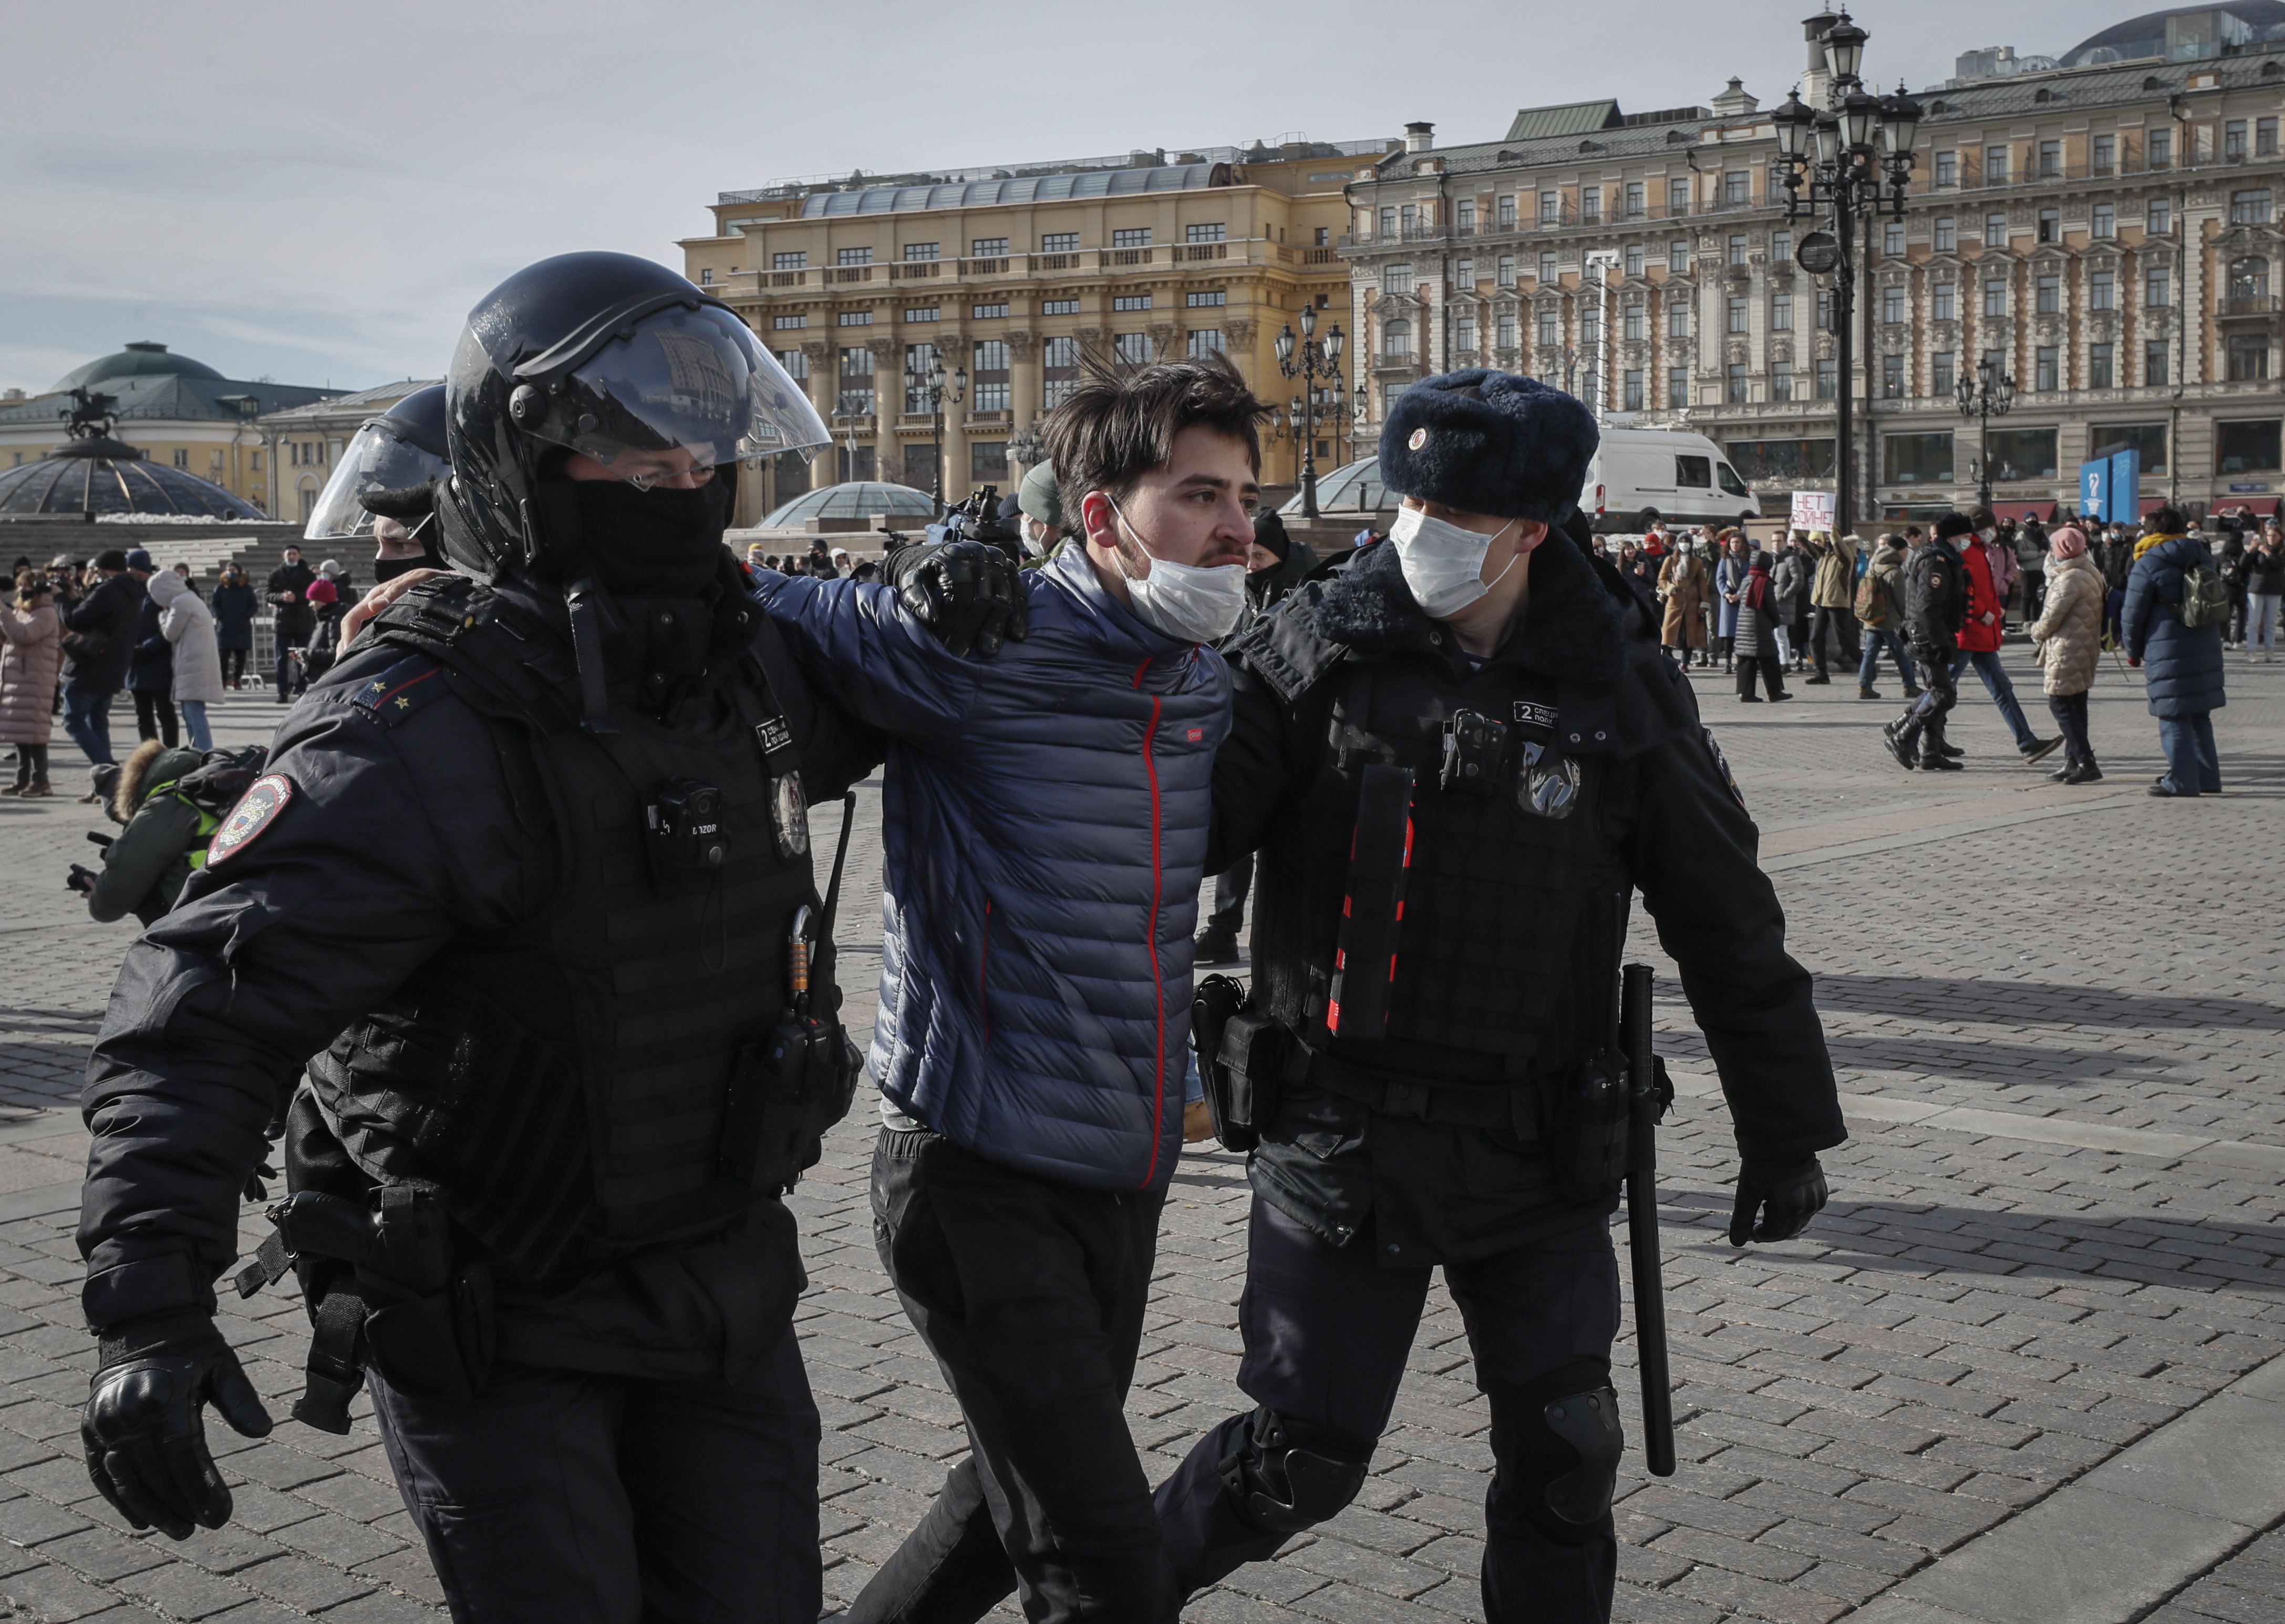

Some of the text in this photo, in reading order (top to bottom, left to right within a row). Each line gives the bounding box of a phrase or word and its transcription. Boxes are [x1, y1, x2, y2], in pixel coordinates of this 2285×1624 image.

[1795, 494, 1825, 510] НЕТ
[1792, 509, 1833, 525] ВОЙНЕ
[1521, 705, 1532, 720] 2
[1534, 707, 1558, 719] СПЕЦИ
[761, 729, 772, 748] 2
